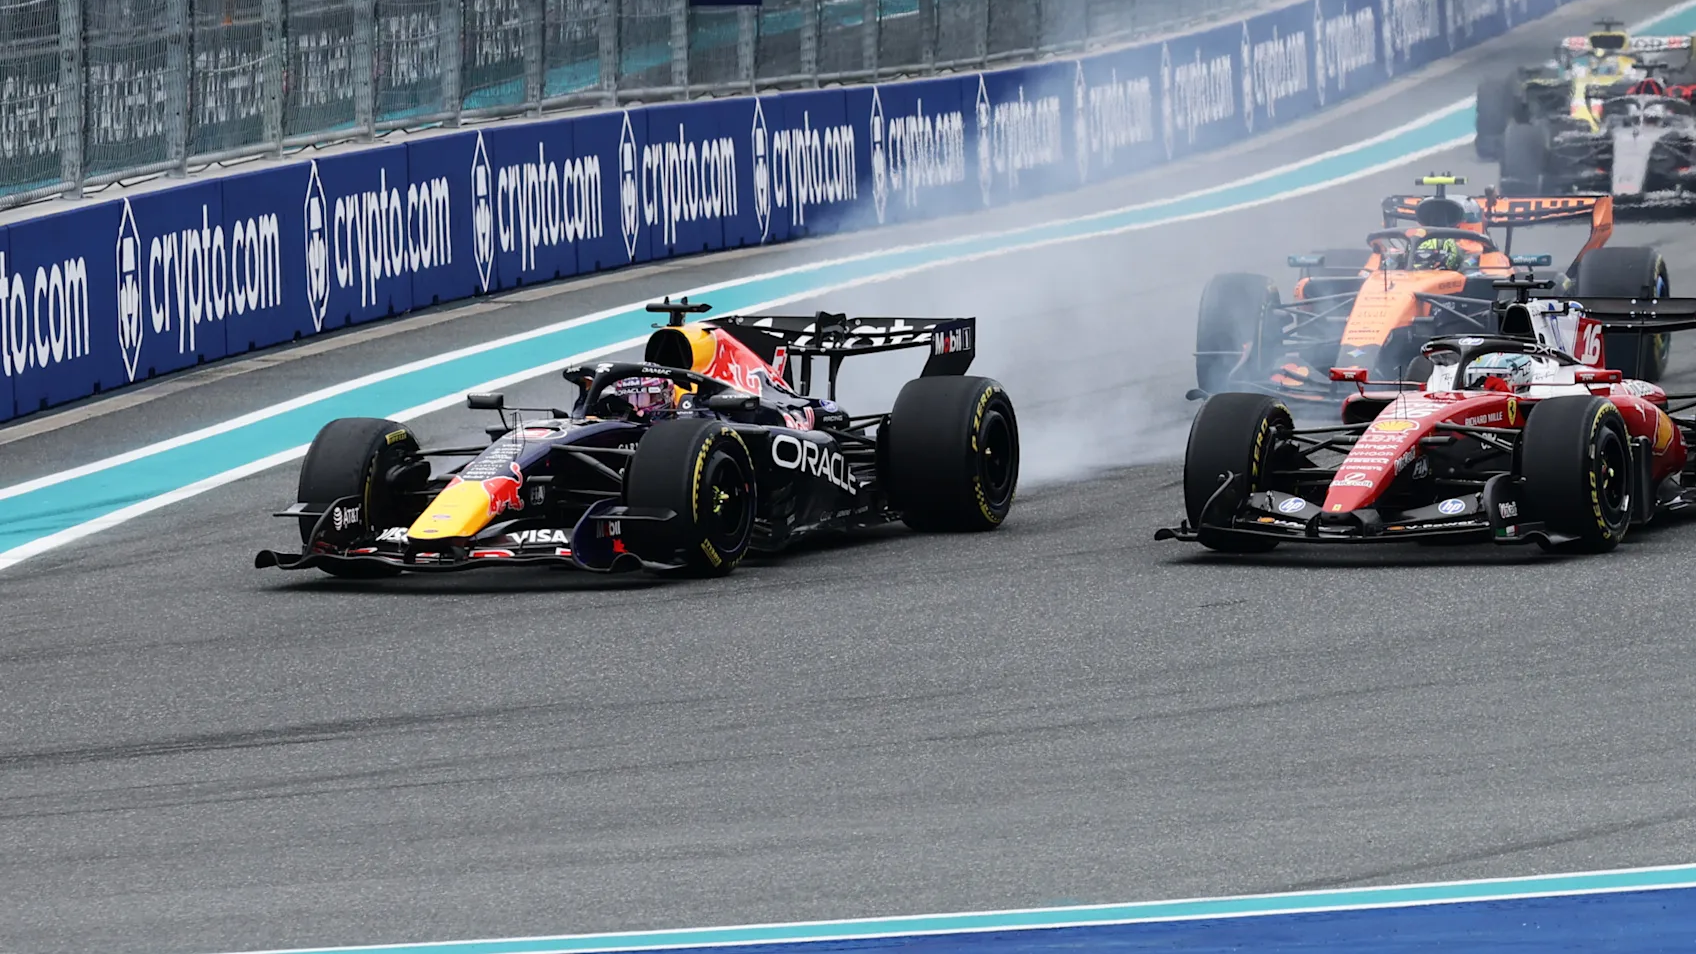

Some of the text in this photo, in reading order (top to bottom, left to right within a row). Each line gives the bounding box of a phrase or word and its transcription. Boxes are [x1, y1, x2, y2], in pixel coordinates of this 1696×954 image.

[773, 110, 857, 225] crypto.com
[888, 98, 965, 209] crypto.com
[642, 123, 738, 244] crypto.com
[498, 143, 603, 271] crypto.com
[333, 168, 452, 308] crypto.com
[149, 204, 282, 354] crypto.com
[935, 327, 972, 355] Mobil 1
[1582, 323, 1602, 365] 16
[642, 367, 672, 376] DAMAC
[973, 386, 993, 433] ZERO
[1465, 411, 1503, 426] RICHARD MILLE
[1360, 434, 1408, 443] IBM
[771, 434, 857, 496] ORACLE
[342, 506, 360, 526] AT&T
[1283, 498, 1302, 513] hp
[1442, 499, 1461, 513] hp
[1589, 471, 1606, 528] ZERO
[507, 529, 569, 544] VISA
